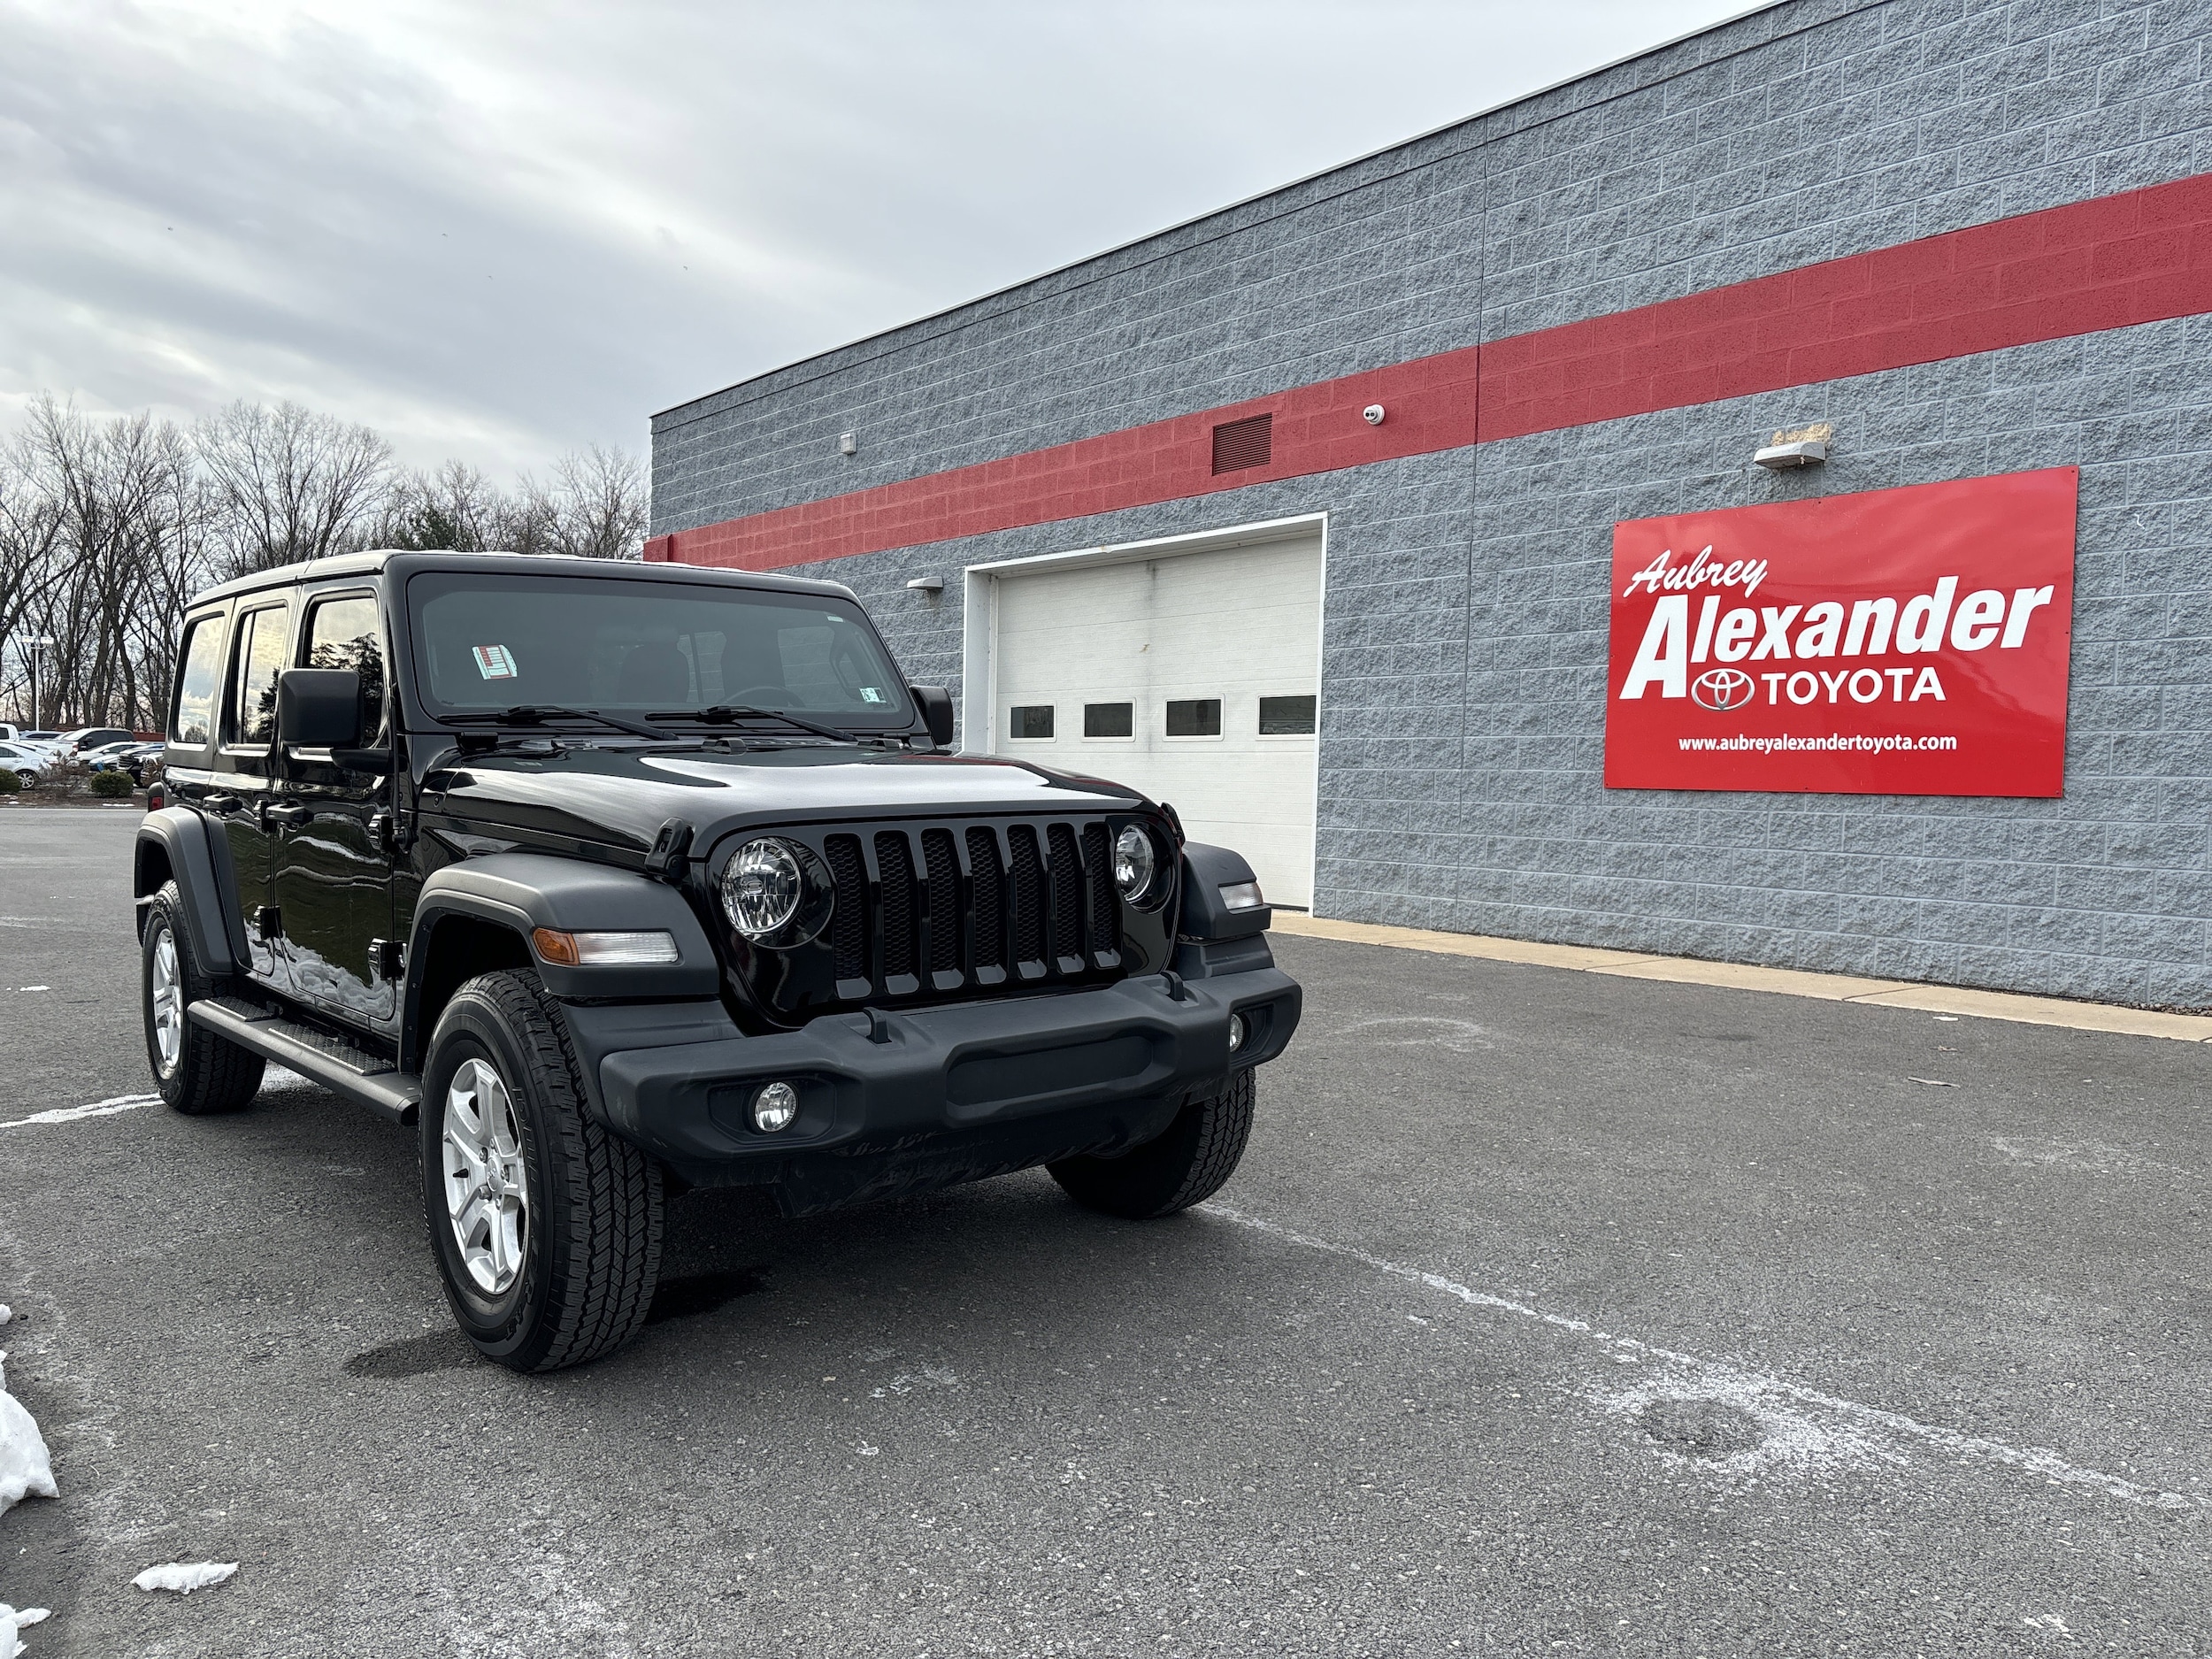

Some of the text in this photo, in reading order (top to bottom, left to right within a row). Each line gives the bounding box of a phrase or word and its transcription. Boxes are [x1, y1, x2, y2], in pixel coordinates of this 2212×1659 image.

[1623, 544, 1768, 598] Aubrey
[1618, 575, 2055, 700] Alexander
[1761, 666, 1947, 705] TOYOTA
[1678, 733, 1957, 755] www.aubreyalexandertoyota.com
